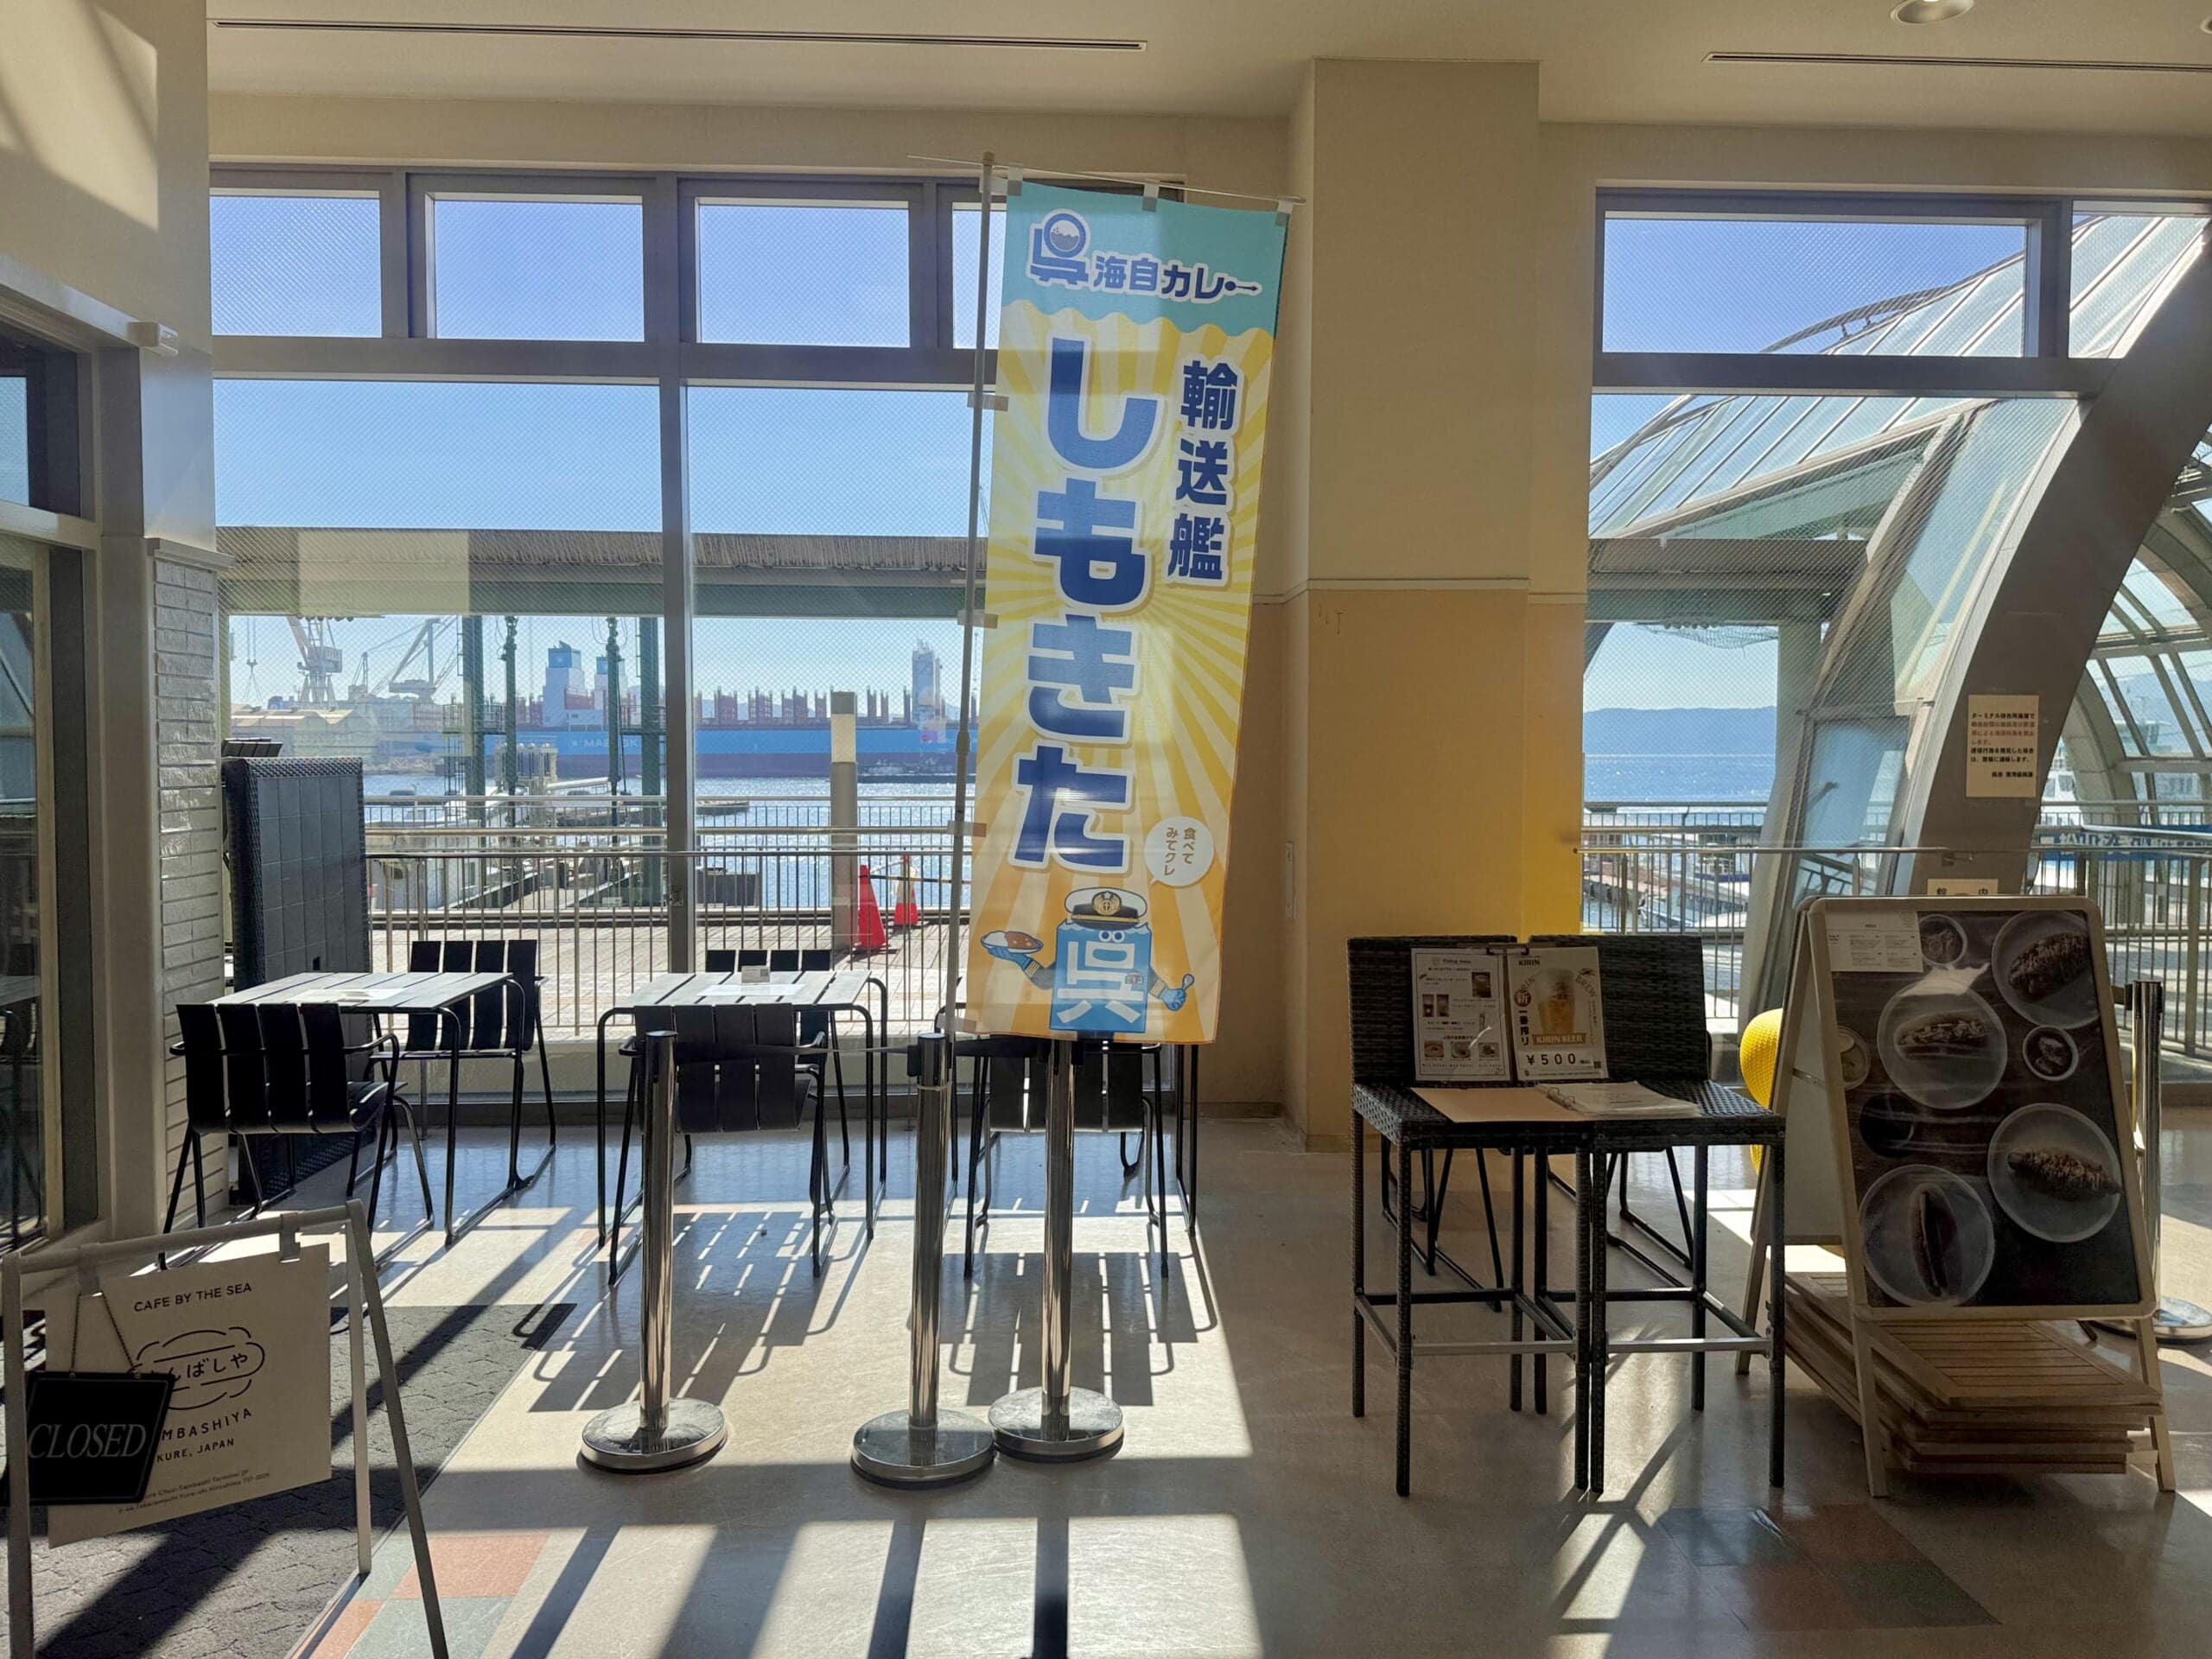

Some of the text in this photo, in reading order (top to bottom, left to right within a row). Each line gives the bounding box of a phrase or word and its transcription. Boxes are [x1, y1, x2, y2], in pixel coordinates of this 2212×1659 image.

[1167, 359, 1239, 580] 輸送艦
[1014, 337, 1160, 868] しもきた
[584, 739, 638, 747] MAESK
[1164, 827, 1179, 876] みてクレ
[1182, 827, 1197, 864] 食べて
[1057, 940, 1147, 1023] 呉
[134, 1283, 252, 1312] CAFE BY THE SEA
[29, 1424, 146, 1459] CLOSED
[197, 1438, 234, 1453] JAPAN
